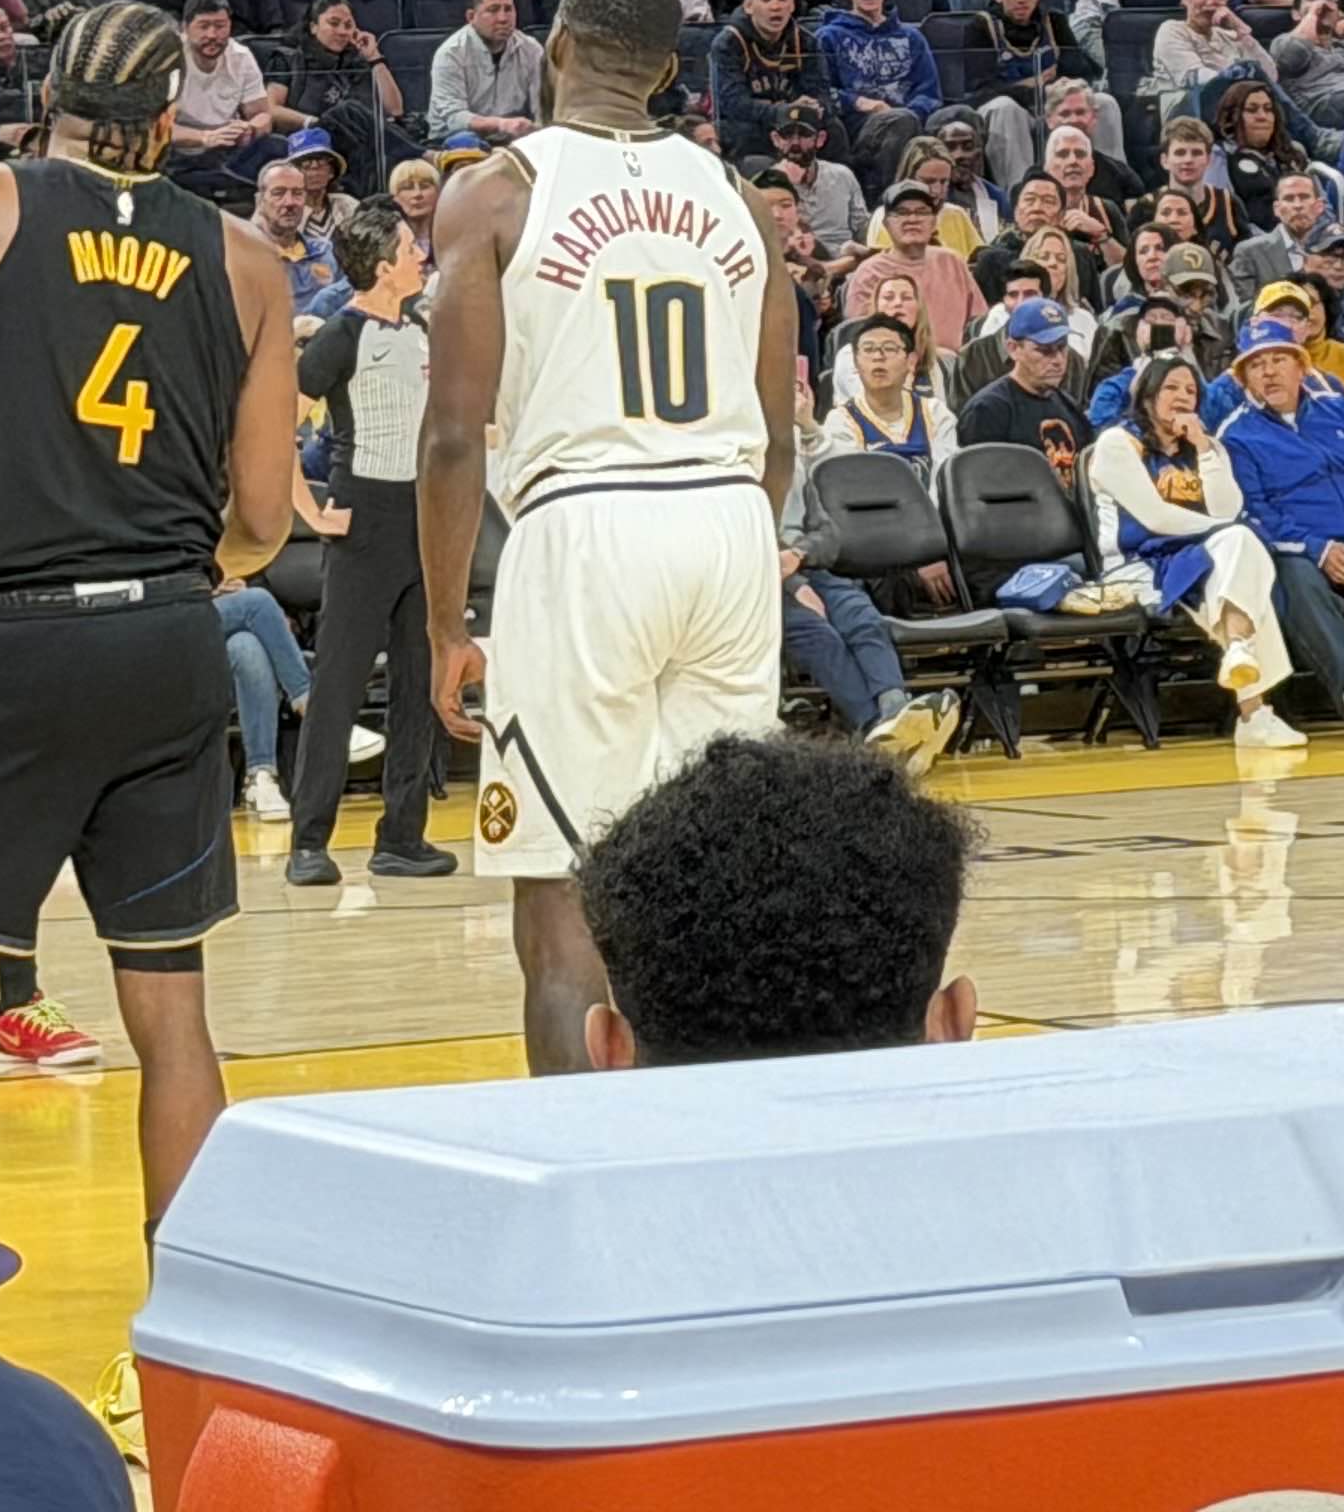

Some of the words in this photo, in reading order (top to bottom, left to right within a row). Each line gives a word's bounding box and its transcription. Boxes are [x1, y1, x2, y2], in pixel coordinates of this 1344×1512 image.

[67, 230, 191, 300] MOODY
[536, 188, 721, 292] HARDAWAY
[713, 238, 755, 299] JR.
[76, 322, 156, 465] 4
[604, 278, 710, 425] 10
